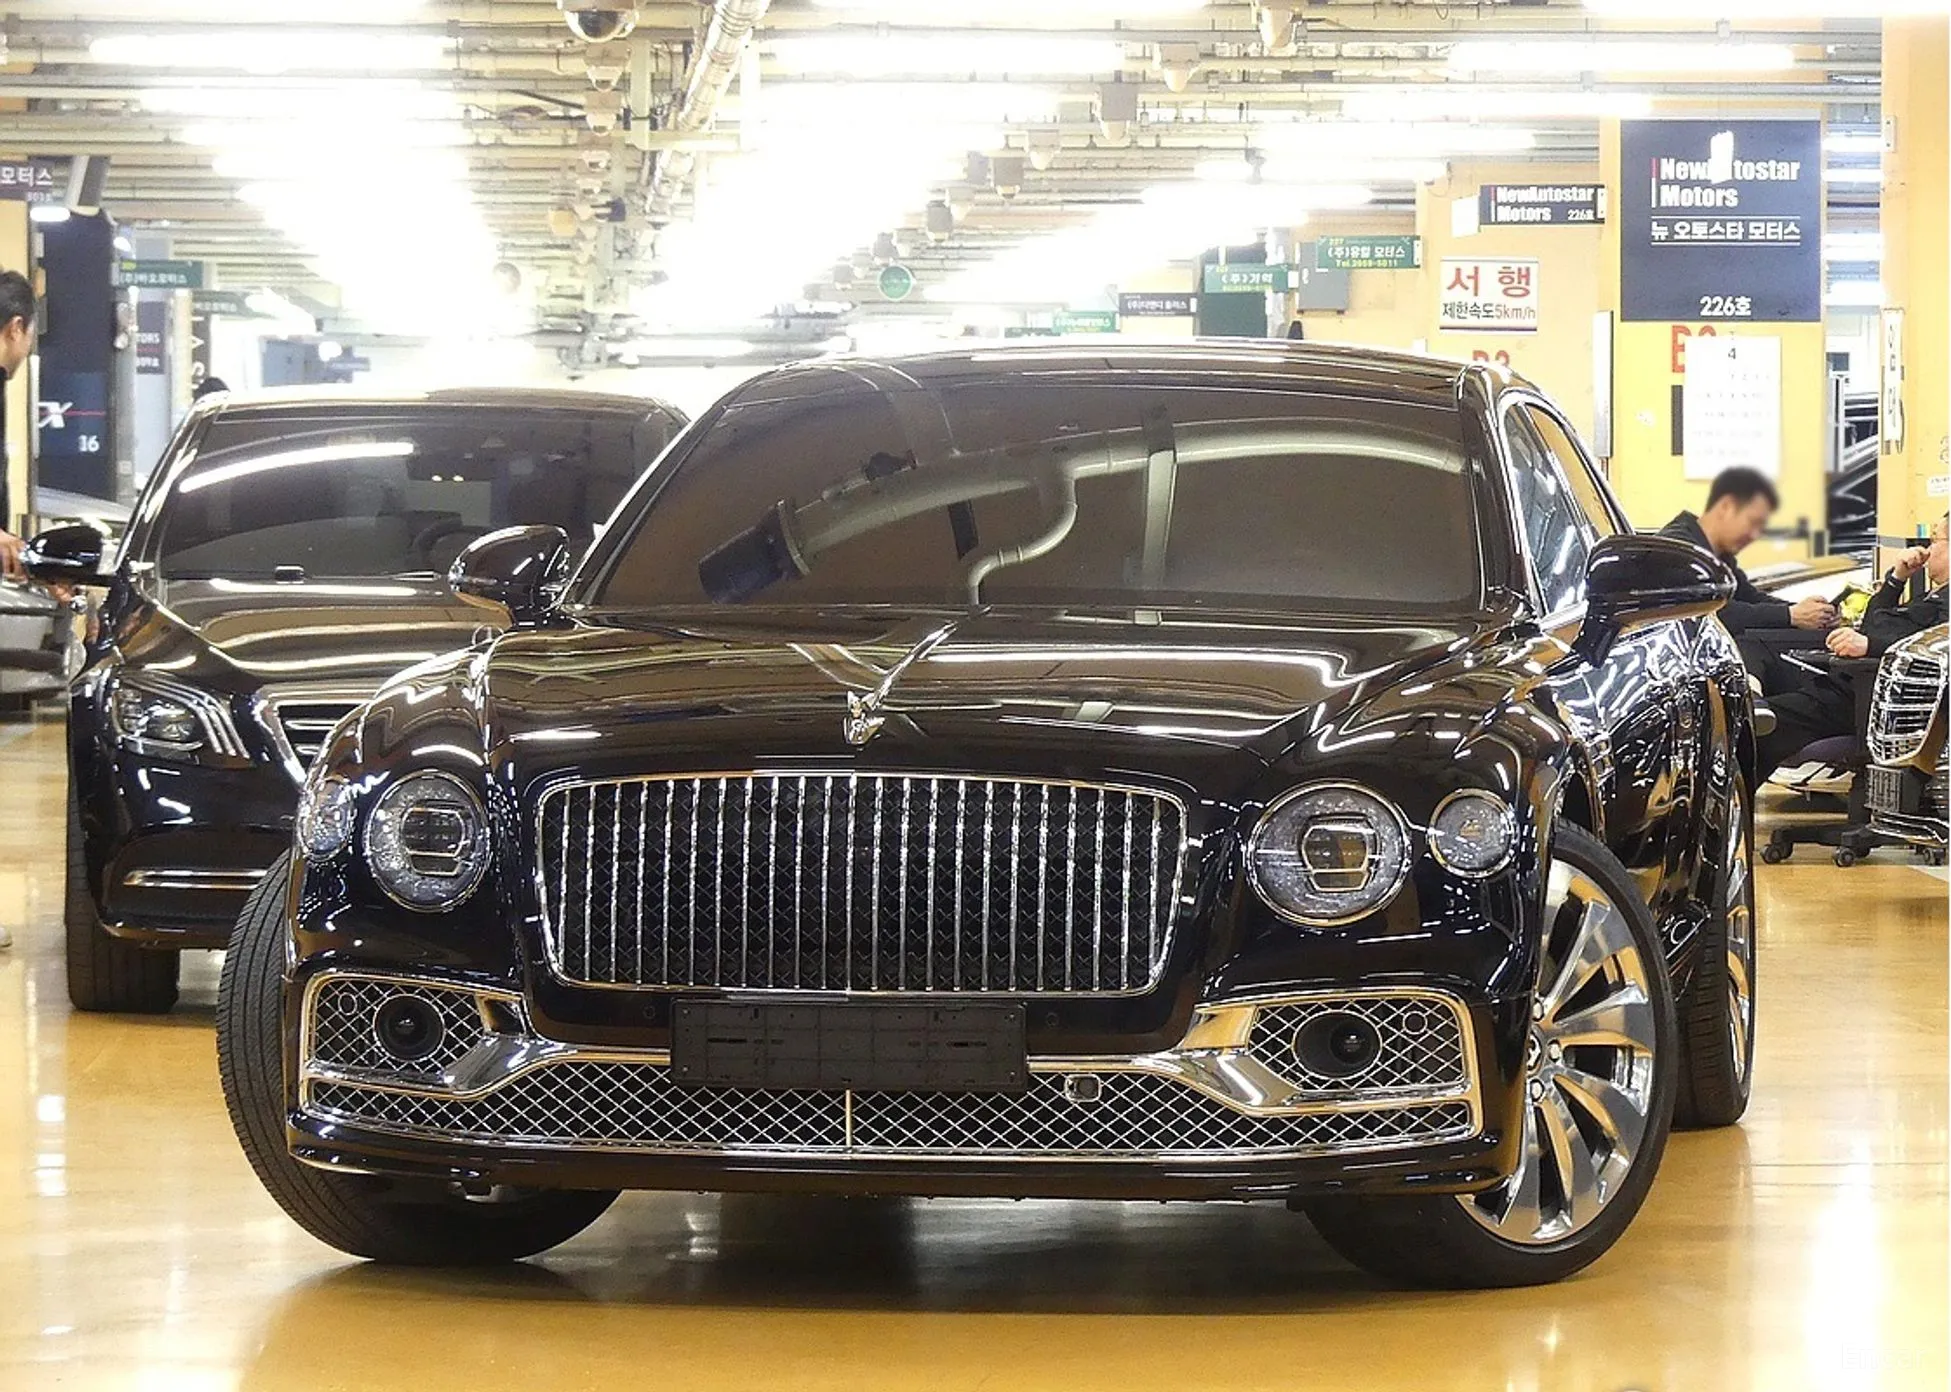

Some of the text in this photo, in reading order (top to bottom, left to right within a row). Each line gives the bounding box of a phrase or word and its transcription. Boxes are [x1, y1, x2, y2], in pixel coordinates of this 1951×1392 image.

[0, 166, 54, 187] 모터스
[1496, 186, 1594, 202] NewAutostar
[1660, 184, 1739, 207] Motors
[1497, 206, 1552, 221] Motors
[1651, 221, 1800, 240] 뉴 오토스타 모터스
[1447, 265, 1531, 298] 서 행
[1700, 296, 1751, 316] 226호
[1728, 347, 1737, 360] 4
[79, 435, 100, 452] 16
